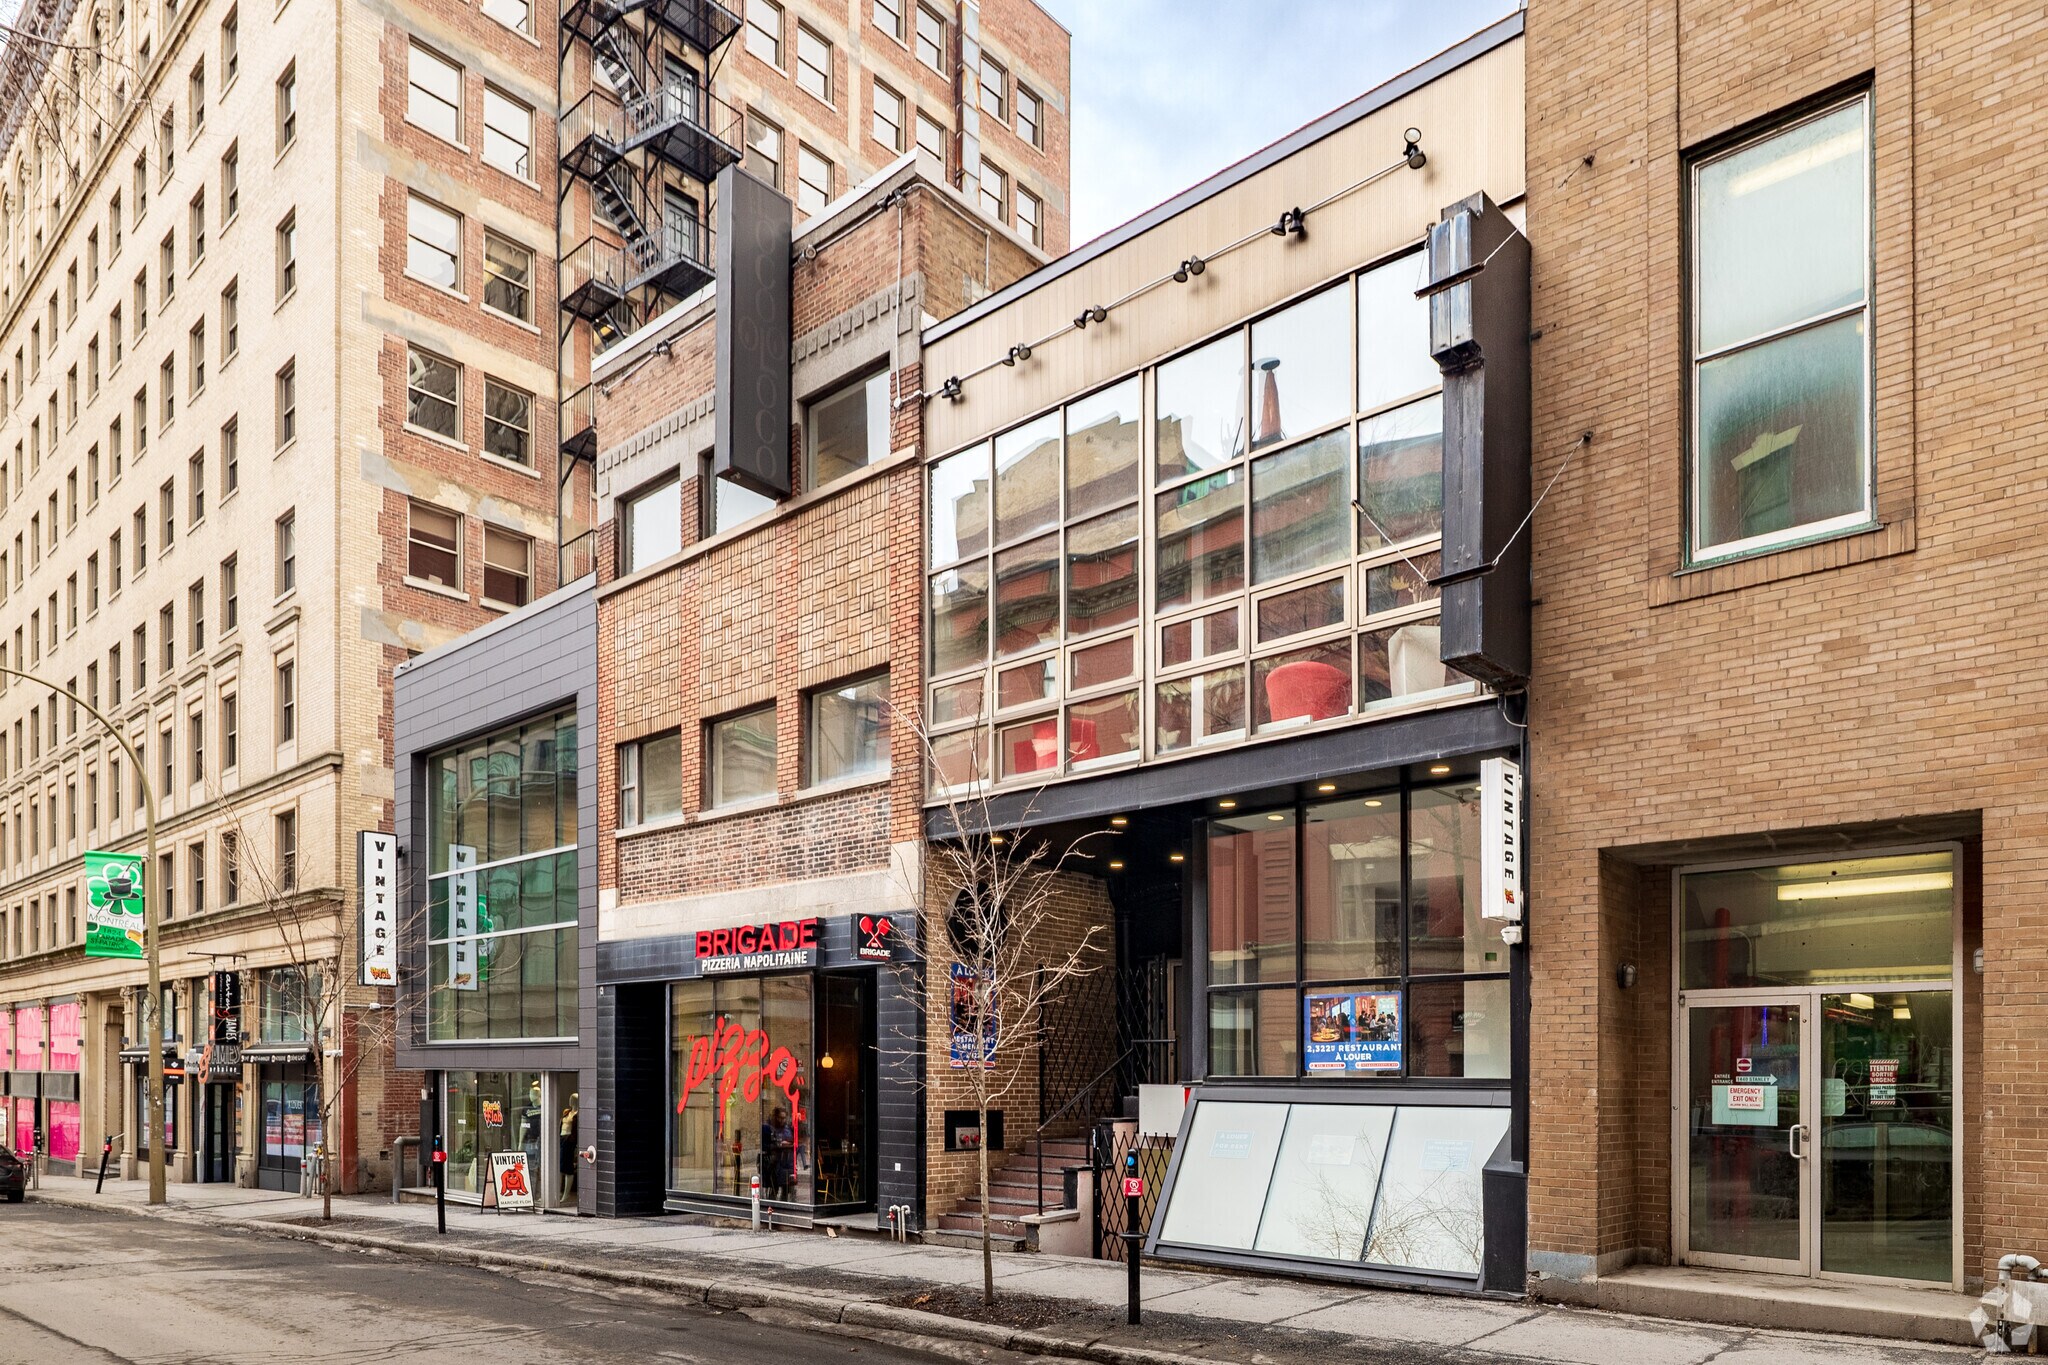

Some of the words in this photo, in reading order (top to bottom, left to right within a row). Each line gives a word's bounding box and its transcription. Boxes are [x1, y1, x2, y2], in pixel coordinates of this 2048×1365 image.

[1504, 773, 1514, 880] VINTAGE
[375, 841, 386, 955] VINTAGE
[89, 914, 140, 930] MONTRÉAL
[695, 916, 819, 959] BRIGADE
[859, 947, 891, 957] BRIGADE
[701, 956, 741, 972] PIZZERIA
[744, 950, 808, 968] NAPOLITAINE
[225, 1018, 237, 1041] JAMES
[1338, 1043, 1402, 1053] RESTAURANT
[1335, 1052, 1342, 1061] À
[1343, 1052, 1372, 1061] LOUER
[1729, 1087, 1761, 1095] EMERGENCY
[1744, 1095, 1758, 1103] ONLY
[494, 1155, 526, 1166] VINTAGE
